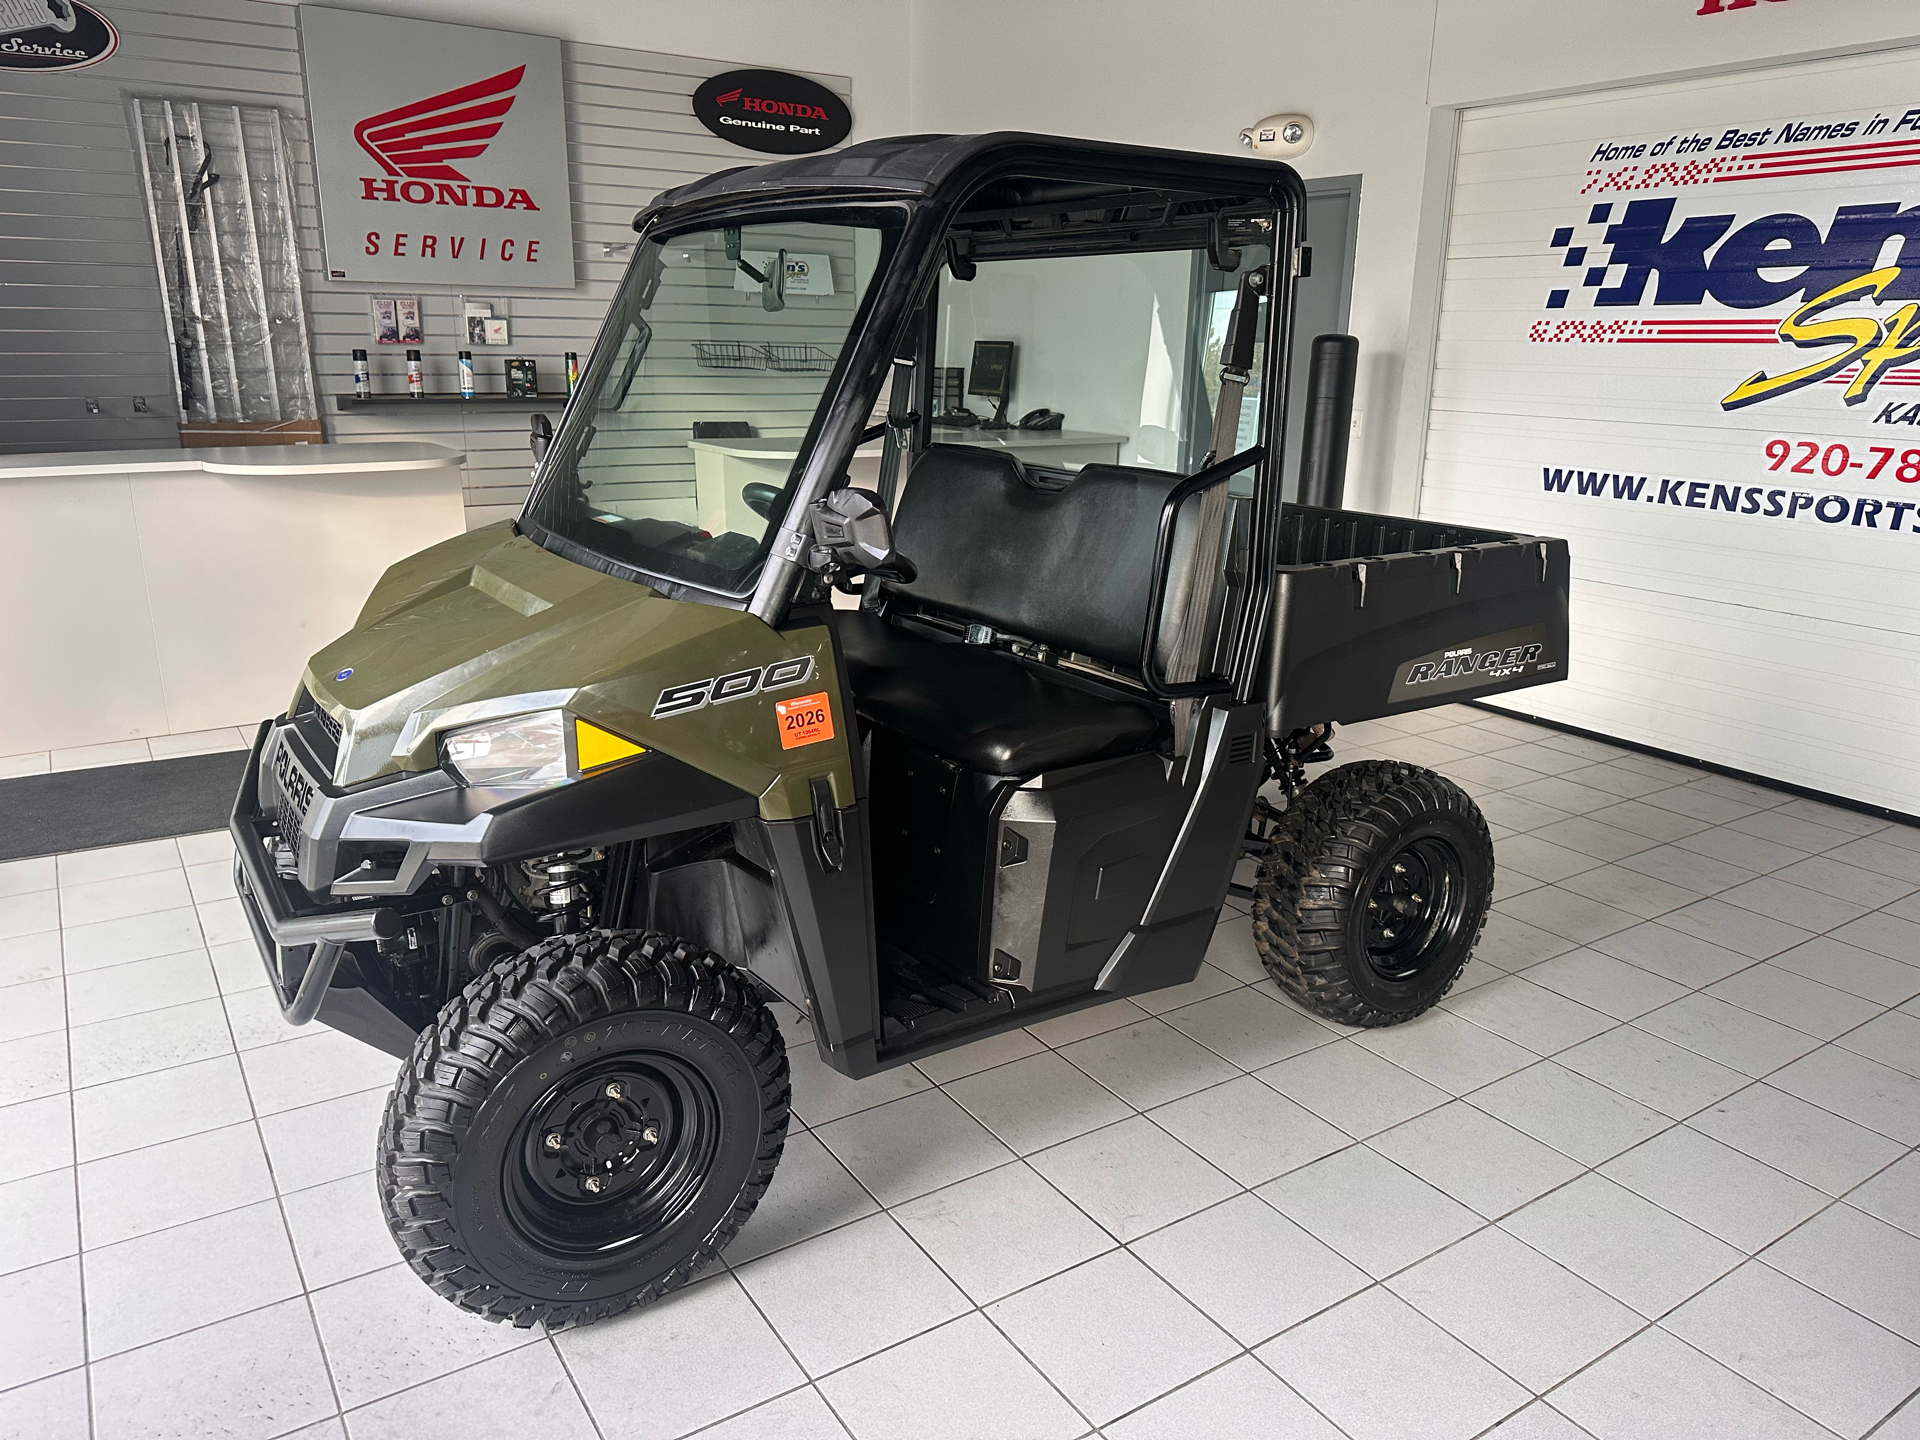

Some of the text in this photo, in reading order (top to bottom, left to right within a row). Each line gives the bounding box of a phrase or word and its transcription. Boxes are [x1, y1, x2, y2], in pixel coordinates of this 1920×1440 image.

[1, 37, 88, 59] Service
[743, 97, 829, 121] HONDA
[719, 116, 821, 136] Genuine Part
[1590, 142, 1647, 163] Home
[1649, 135, 1677, 157] of
[1675, 133, 1713, 154] the
[1714, 127, 1773, 150] Best
[1774, 120, 1861, 145] Names
[1861, 112, 1890, 136] in
[359, 177, 540, 211] HONDA
[365, 231, 540, 263] SERVICE
[1872, 402, 1920, 426] KA
[1765, 439, 1920, 484] 920-78
[1405, 643, 1543, 685] RANGER
[1445, 648, 1473, 659] POLARIS
[651, 655, 815, 720] 500
[785, 708, 825, 731] 2026
[275, 740, 316, 817] POLARIS
